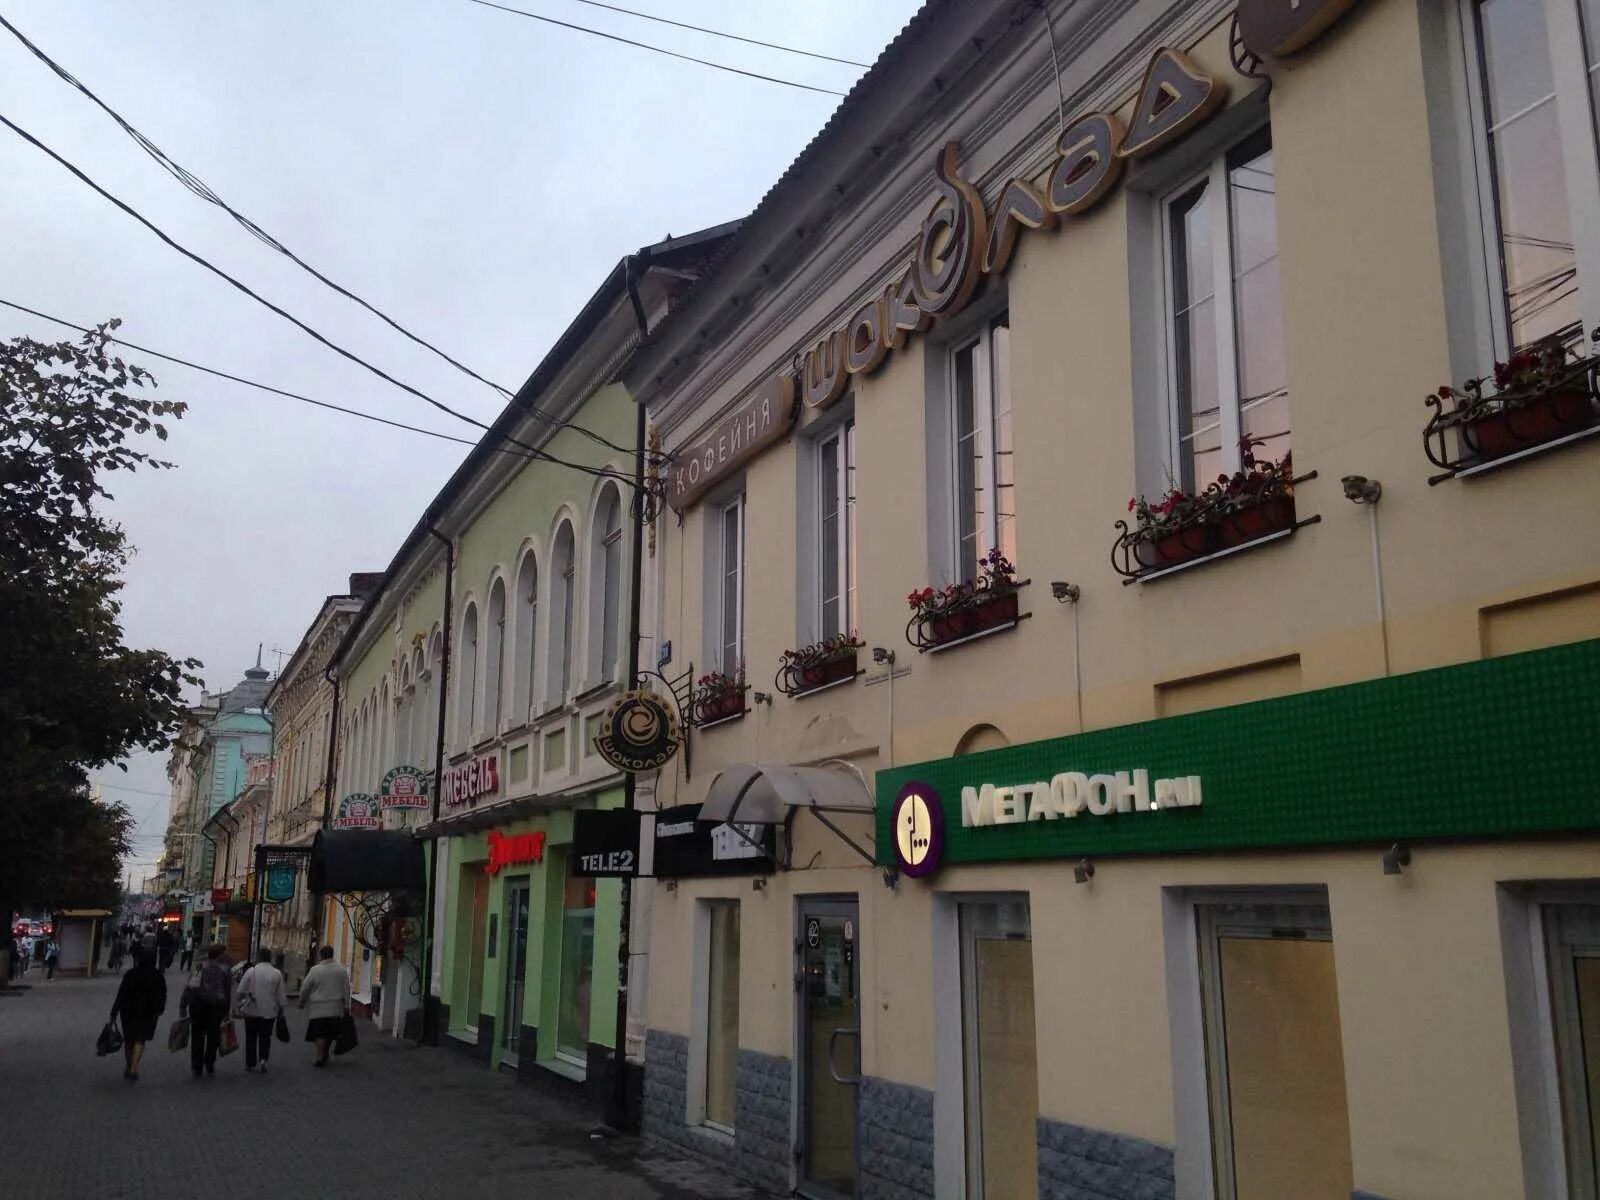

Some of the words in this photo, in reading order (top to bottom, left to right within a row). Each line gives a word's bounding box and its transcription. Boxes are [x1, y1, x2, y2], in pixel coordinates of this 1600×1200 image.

[676, 397, 770, 495] КОФЕЙНЯ
[381, 795, 428, 808] МЕБЕЛЬ
[339, 815, 378, 828] МЕБЕЛЬ
[580, 849, 634, 873] TELE2
